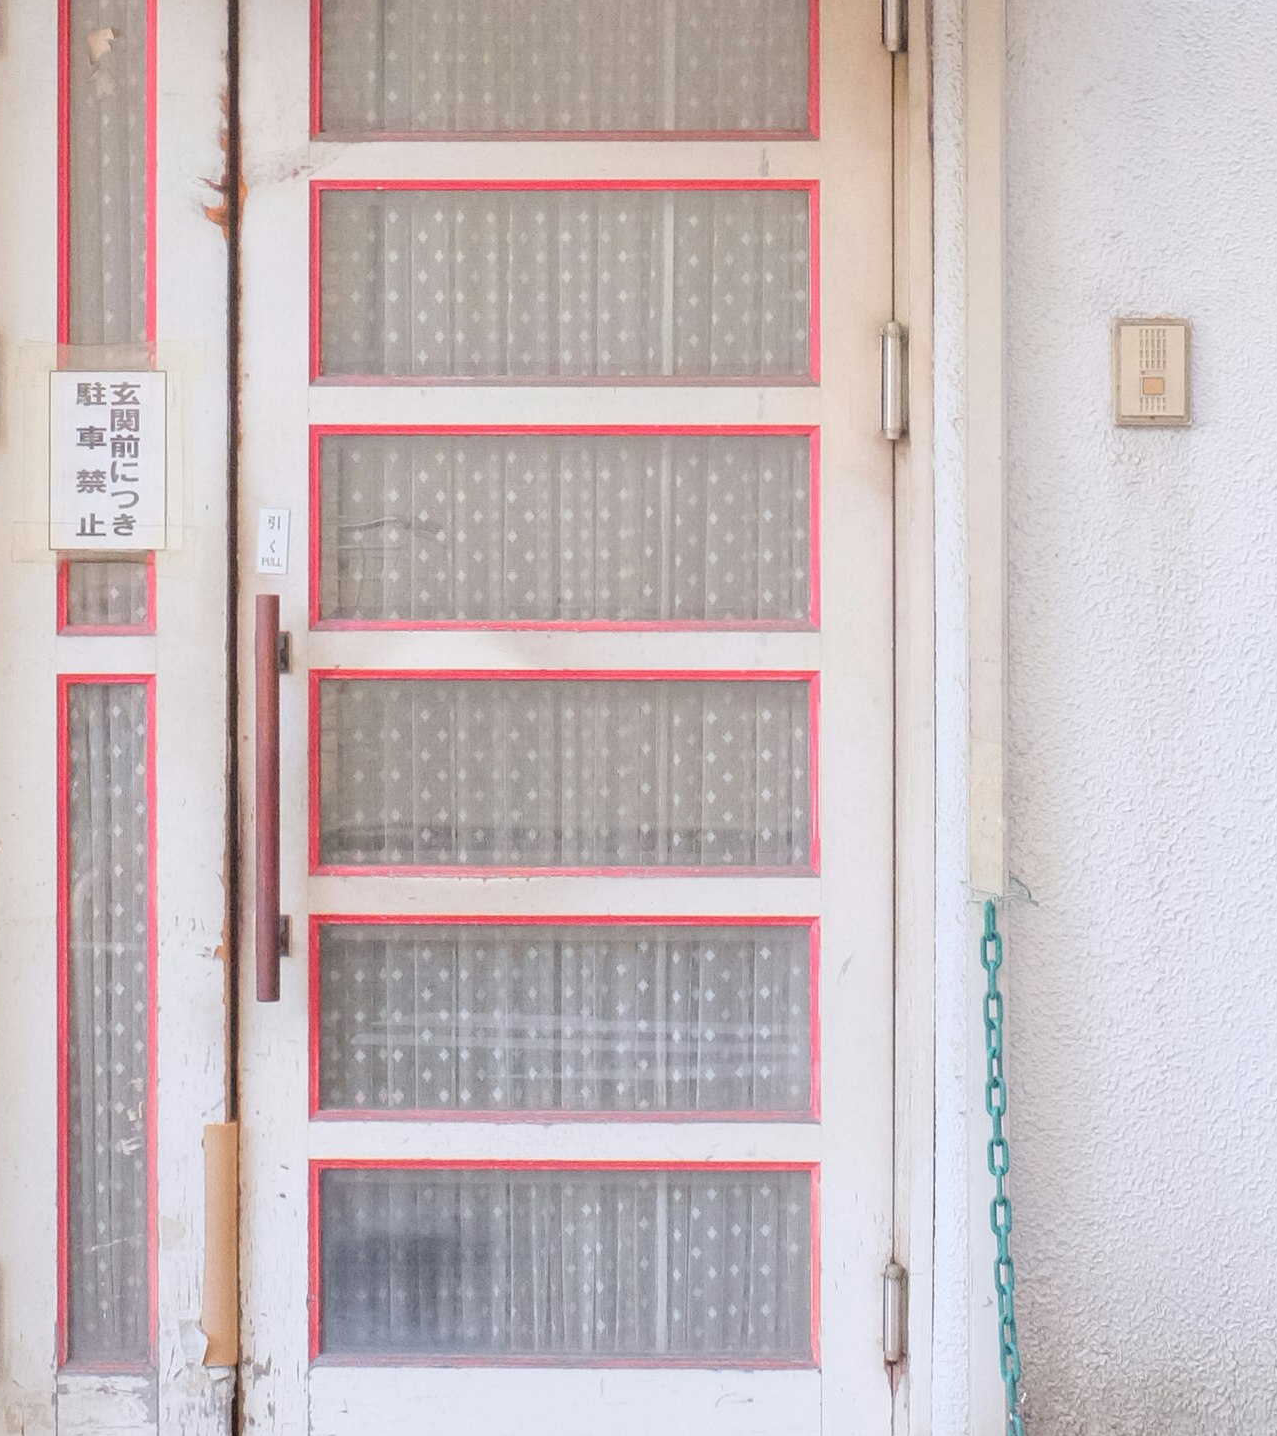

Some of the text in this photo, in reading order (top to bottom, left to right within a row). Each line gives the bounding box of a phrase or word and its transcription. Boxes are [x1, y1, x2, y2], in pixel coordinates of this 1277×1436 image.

[76, 381, 108, 537] 駐車禁止
[110, 381, 141, 537] 玄関前につき
[261, 557, 282, 567] PULL
[268, 515, 281, 554] 引く
